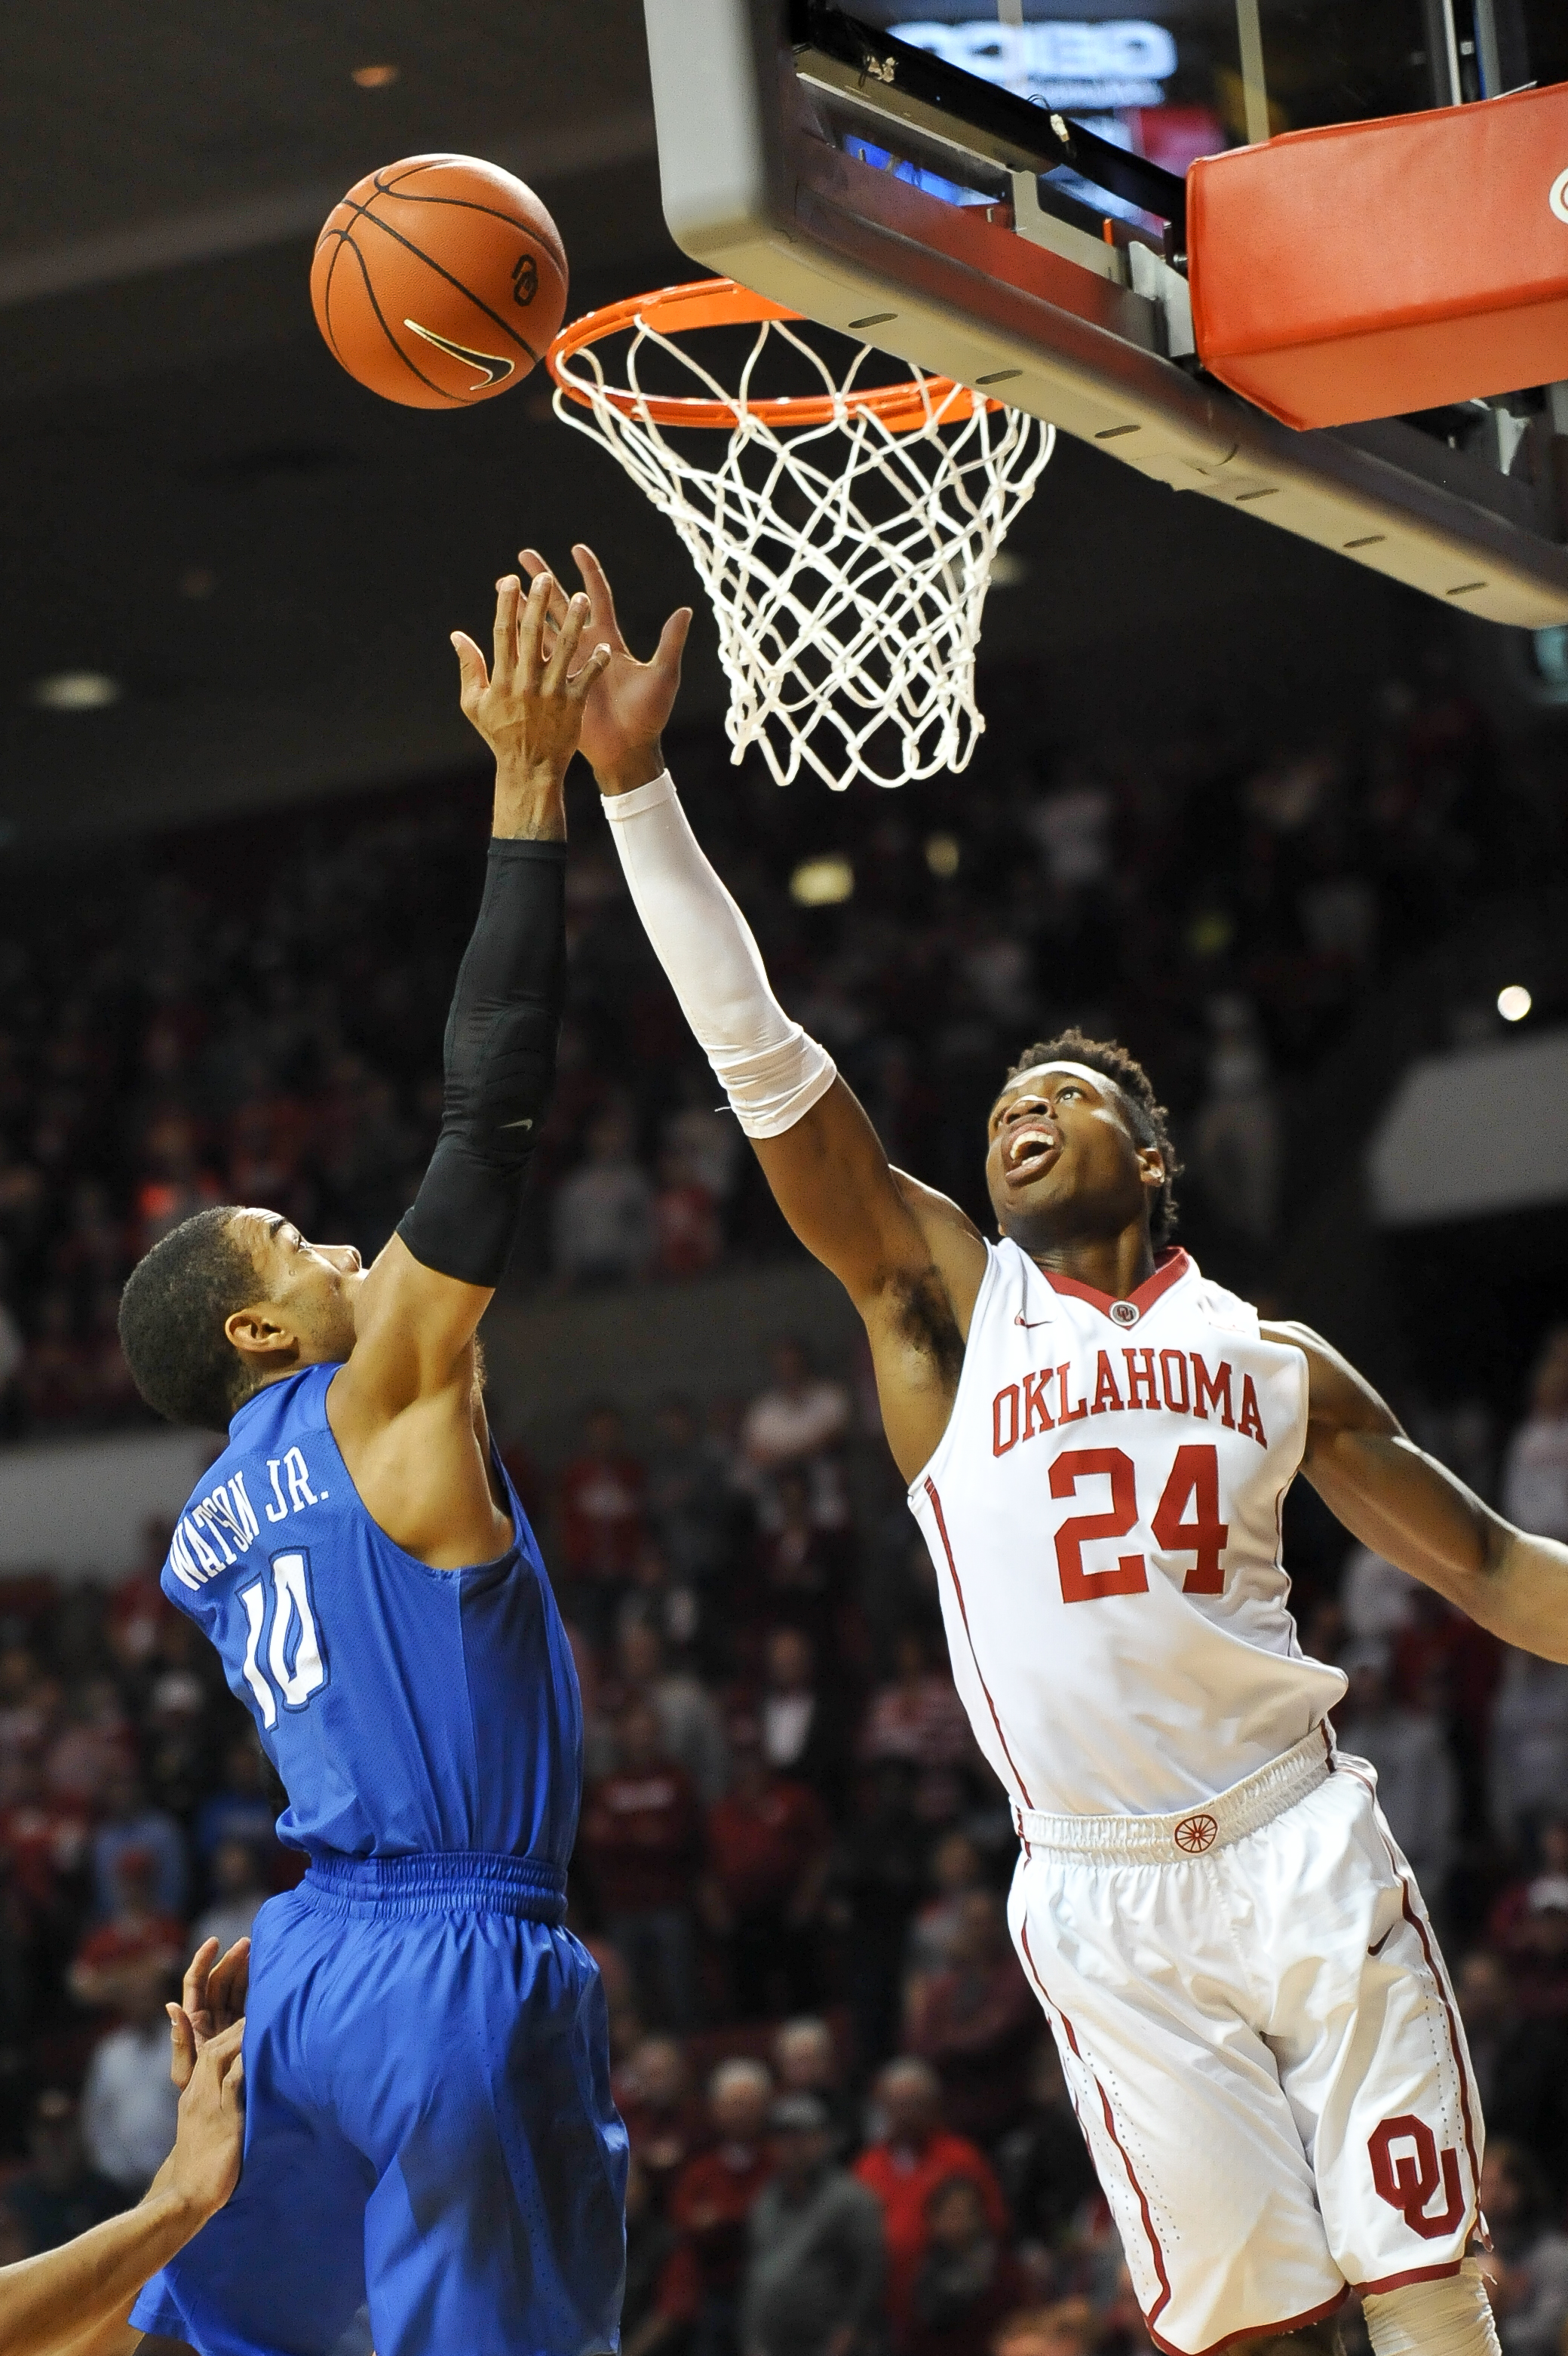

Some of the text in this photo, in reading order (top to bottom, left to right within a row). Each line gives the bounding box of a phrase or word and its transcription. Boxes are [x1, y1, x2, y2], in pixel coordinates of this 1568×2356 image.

[993, 1348, 1268, 1458] OKLAHOMA
[170, 1446, 329, 1591] WATSON JR.
[1048, 1445, 1229, 1603] 24
[235, 1546, 331, 1732] 10
[1367, 2114, 1465, 2240] OU
